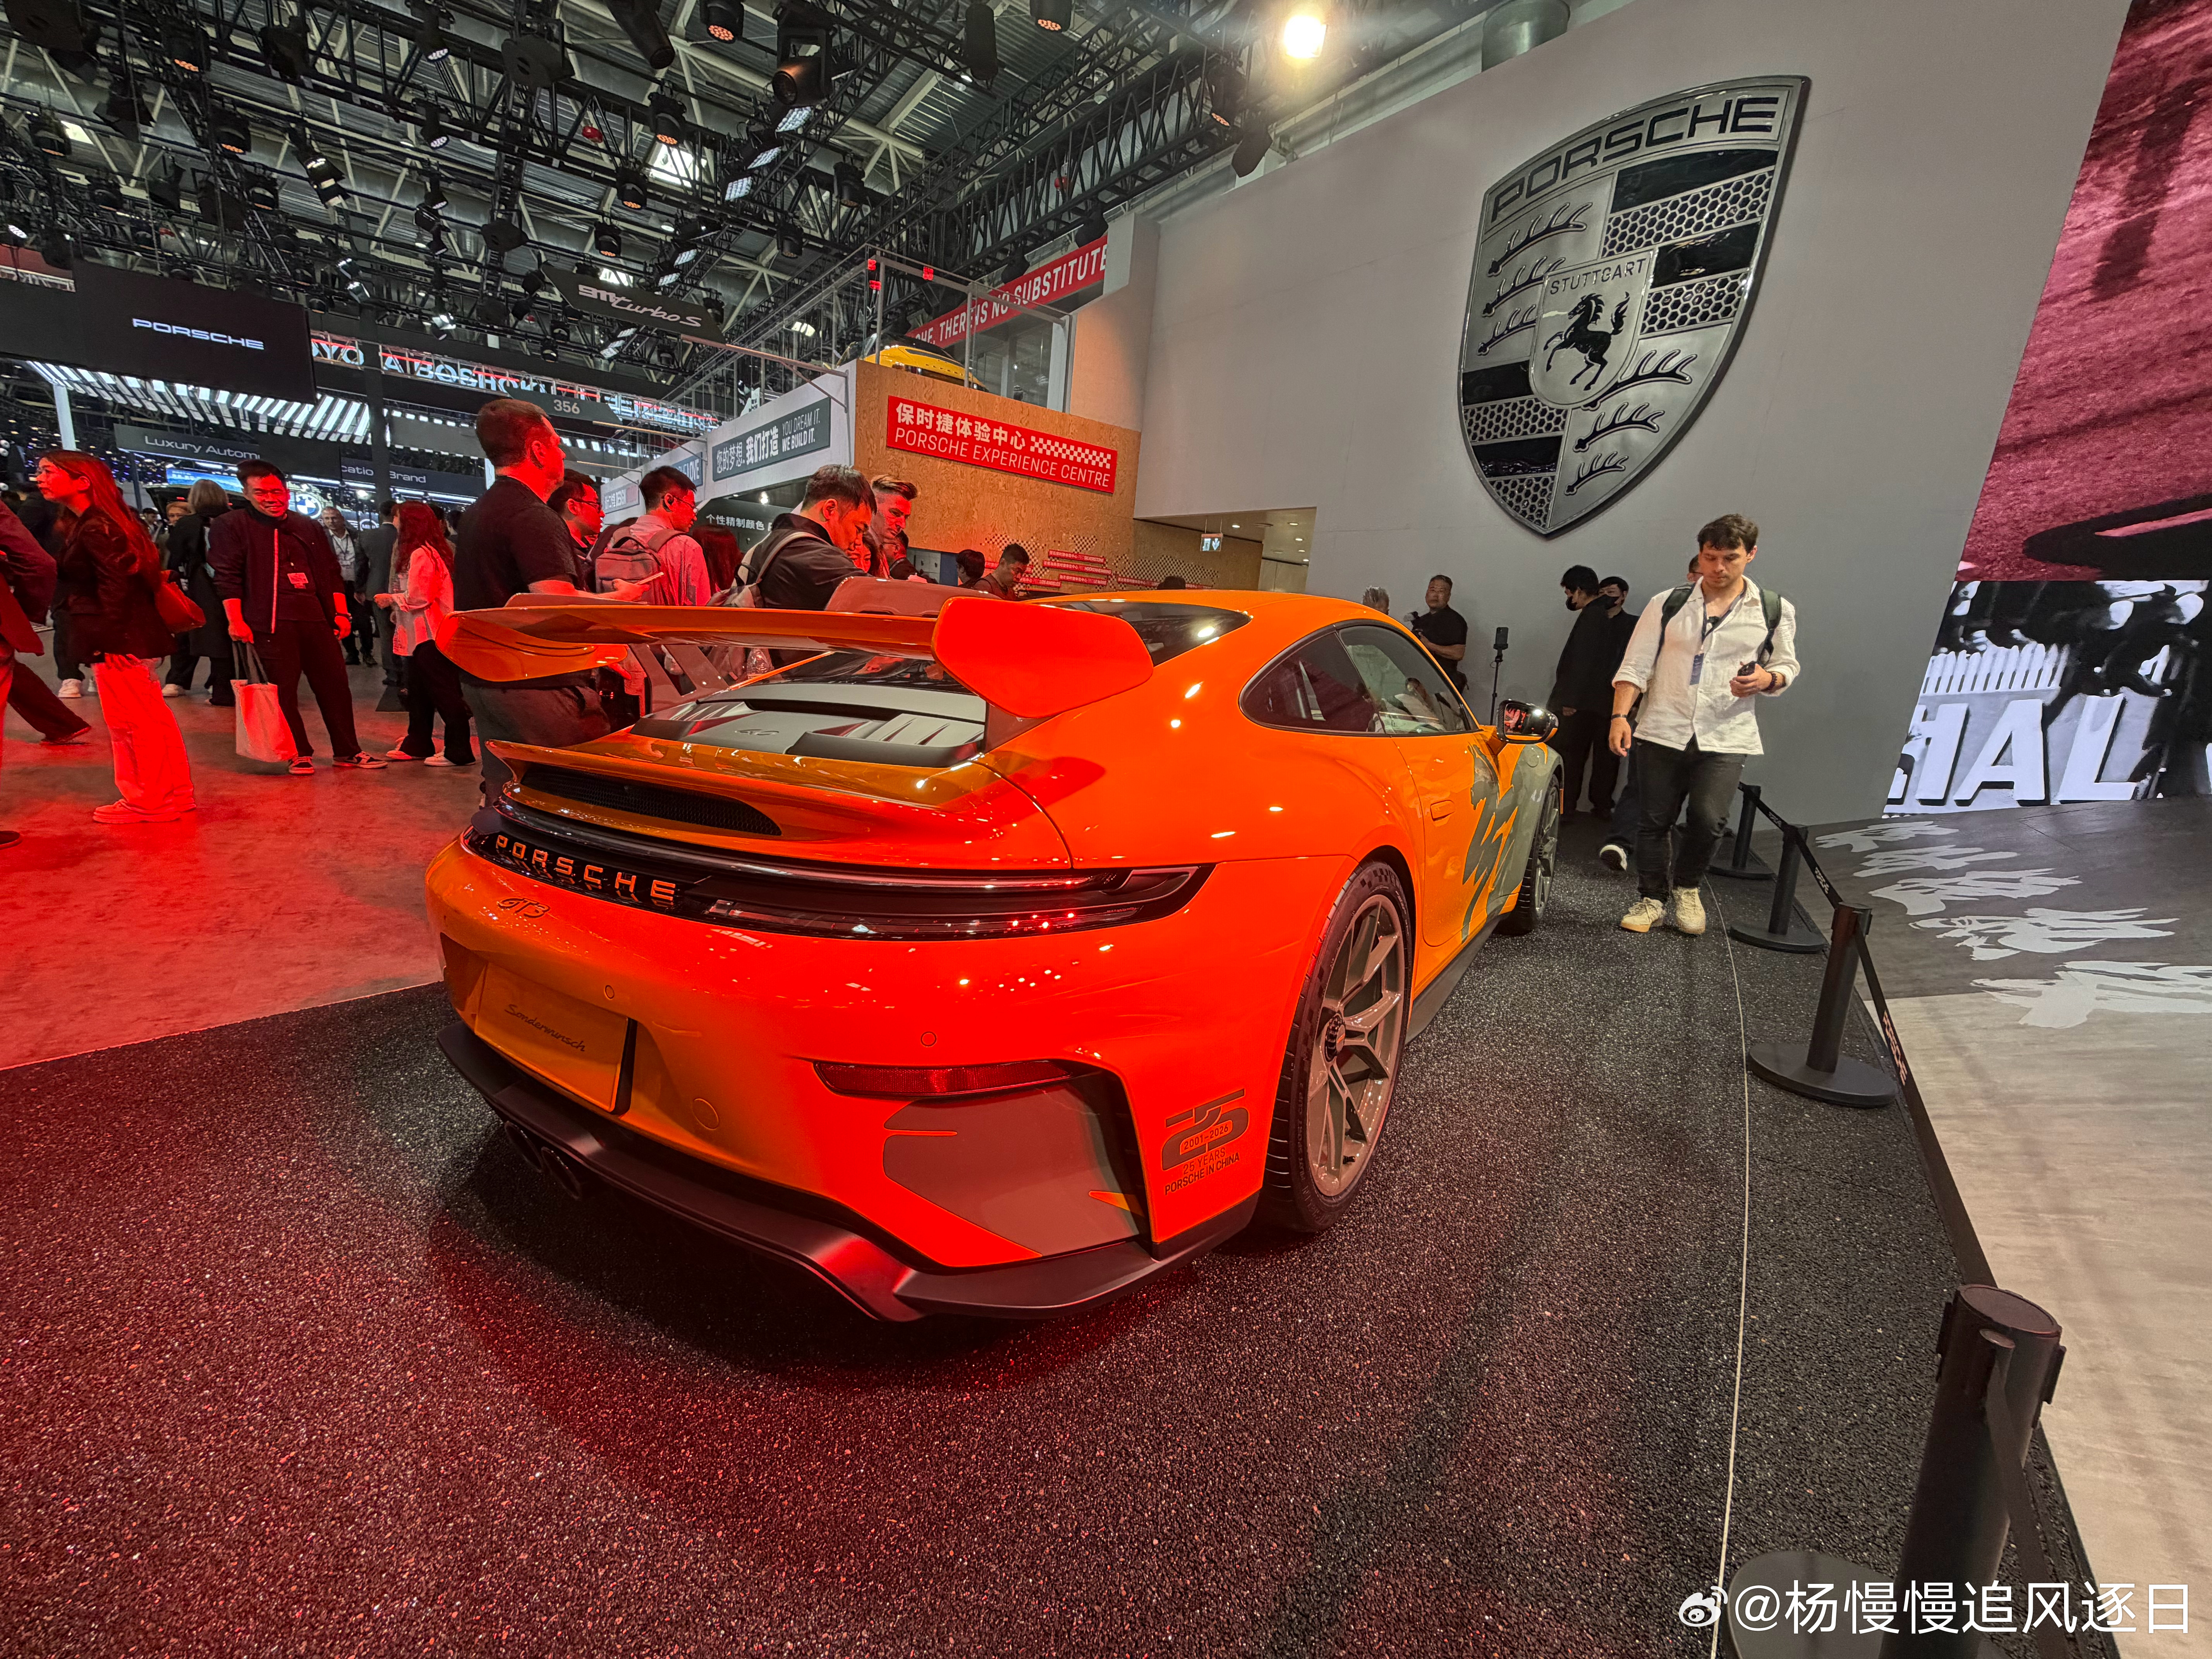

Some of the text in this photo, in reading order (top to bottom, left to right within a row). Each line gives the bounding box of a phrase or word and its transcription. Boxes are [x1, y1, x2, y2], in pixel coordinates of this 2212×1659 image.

[1492, 97, 1779, 222] PORSCHE
[1013, 244, 1108, 306] SUBSTITUTE
[1550, 258, 1645, 295] STUTTGART
[132, 318, 264, 350] PORSCHE
[553, 399, 580, 414] 356
[782, 419, 792, 436] YOU
[794, 411, 812, 433] DREAM
[896, 402, 1026, 450] 保时捷体验中心
[145, 436, 202, 453] Luxury
[782, 437, 790, 452] WE
[791, 431, 807, 449] BUILD
[895, 428, 1111, 487] PORSCHE EXPERIENCE CENTRE
[706, 514, 765, 531] 个性精制颜色
[495, 835, 676, 902] PORSCHE
[497, 898, 551, 918] GT3
[504, 1004, 585, 1052] Sonderwunsch
[1183, 1123, 1228, 1150] 2001-2026
[1165, 1152, 1240, 1196] PORSCHE IN CHINA
[1183, 1147, 1226, 1175] 25 YEARS
